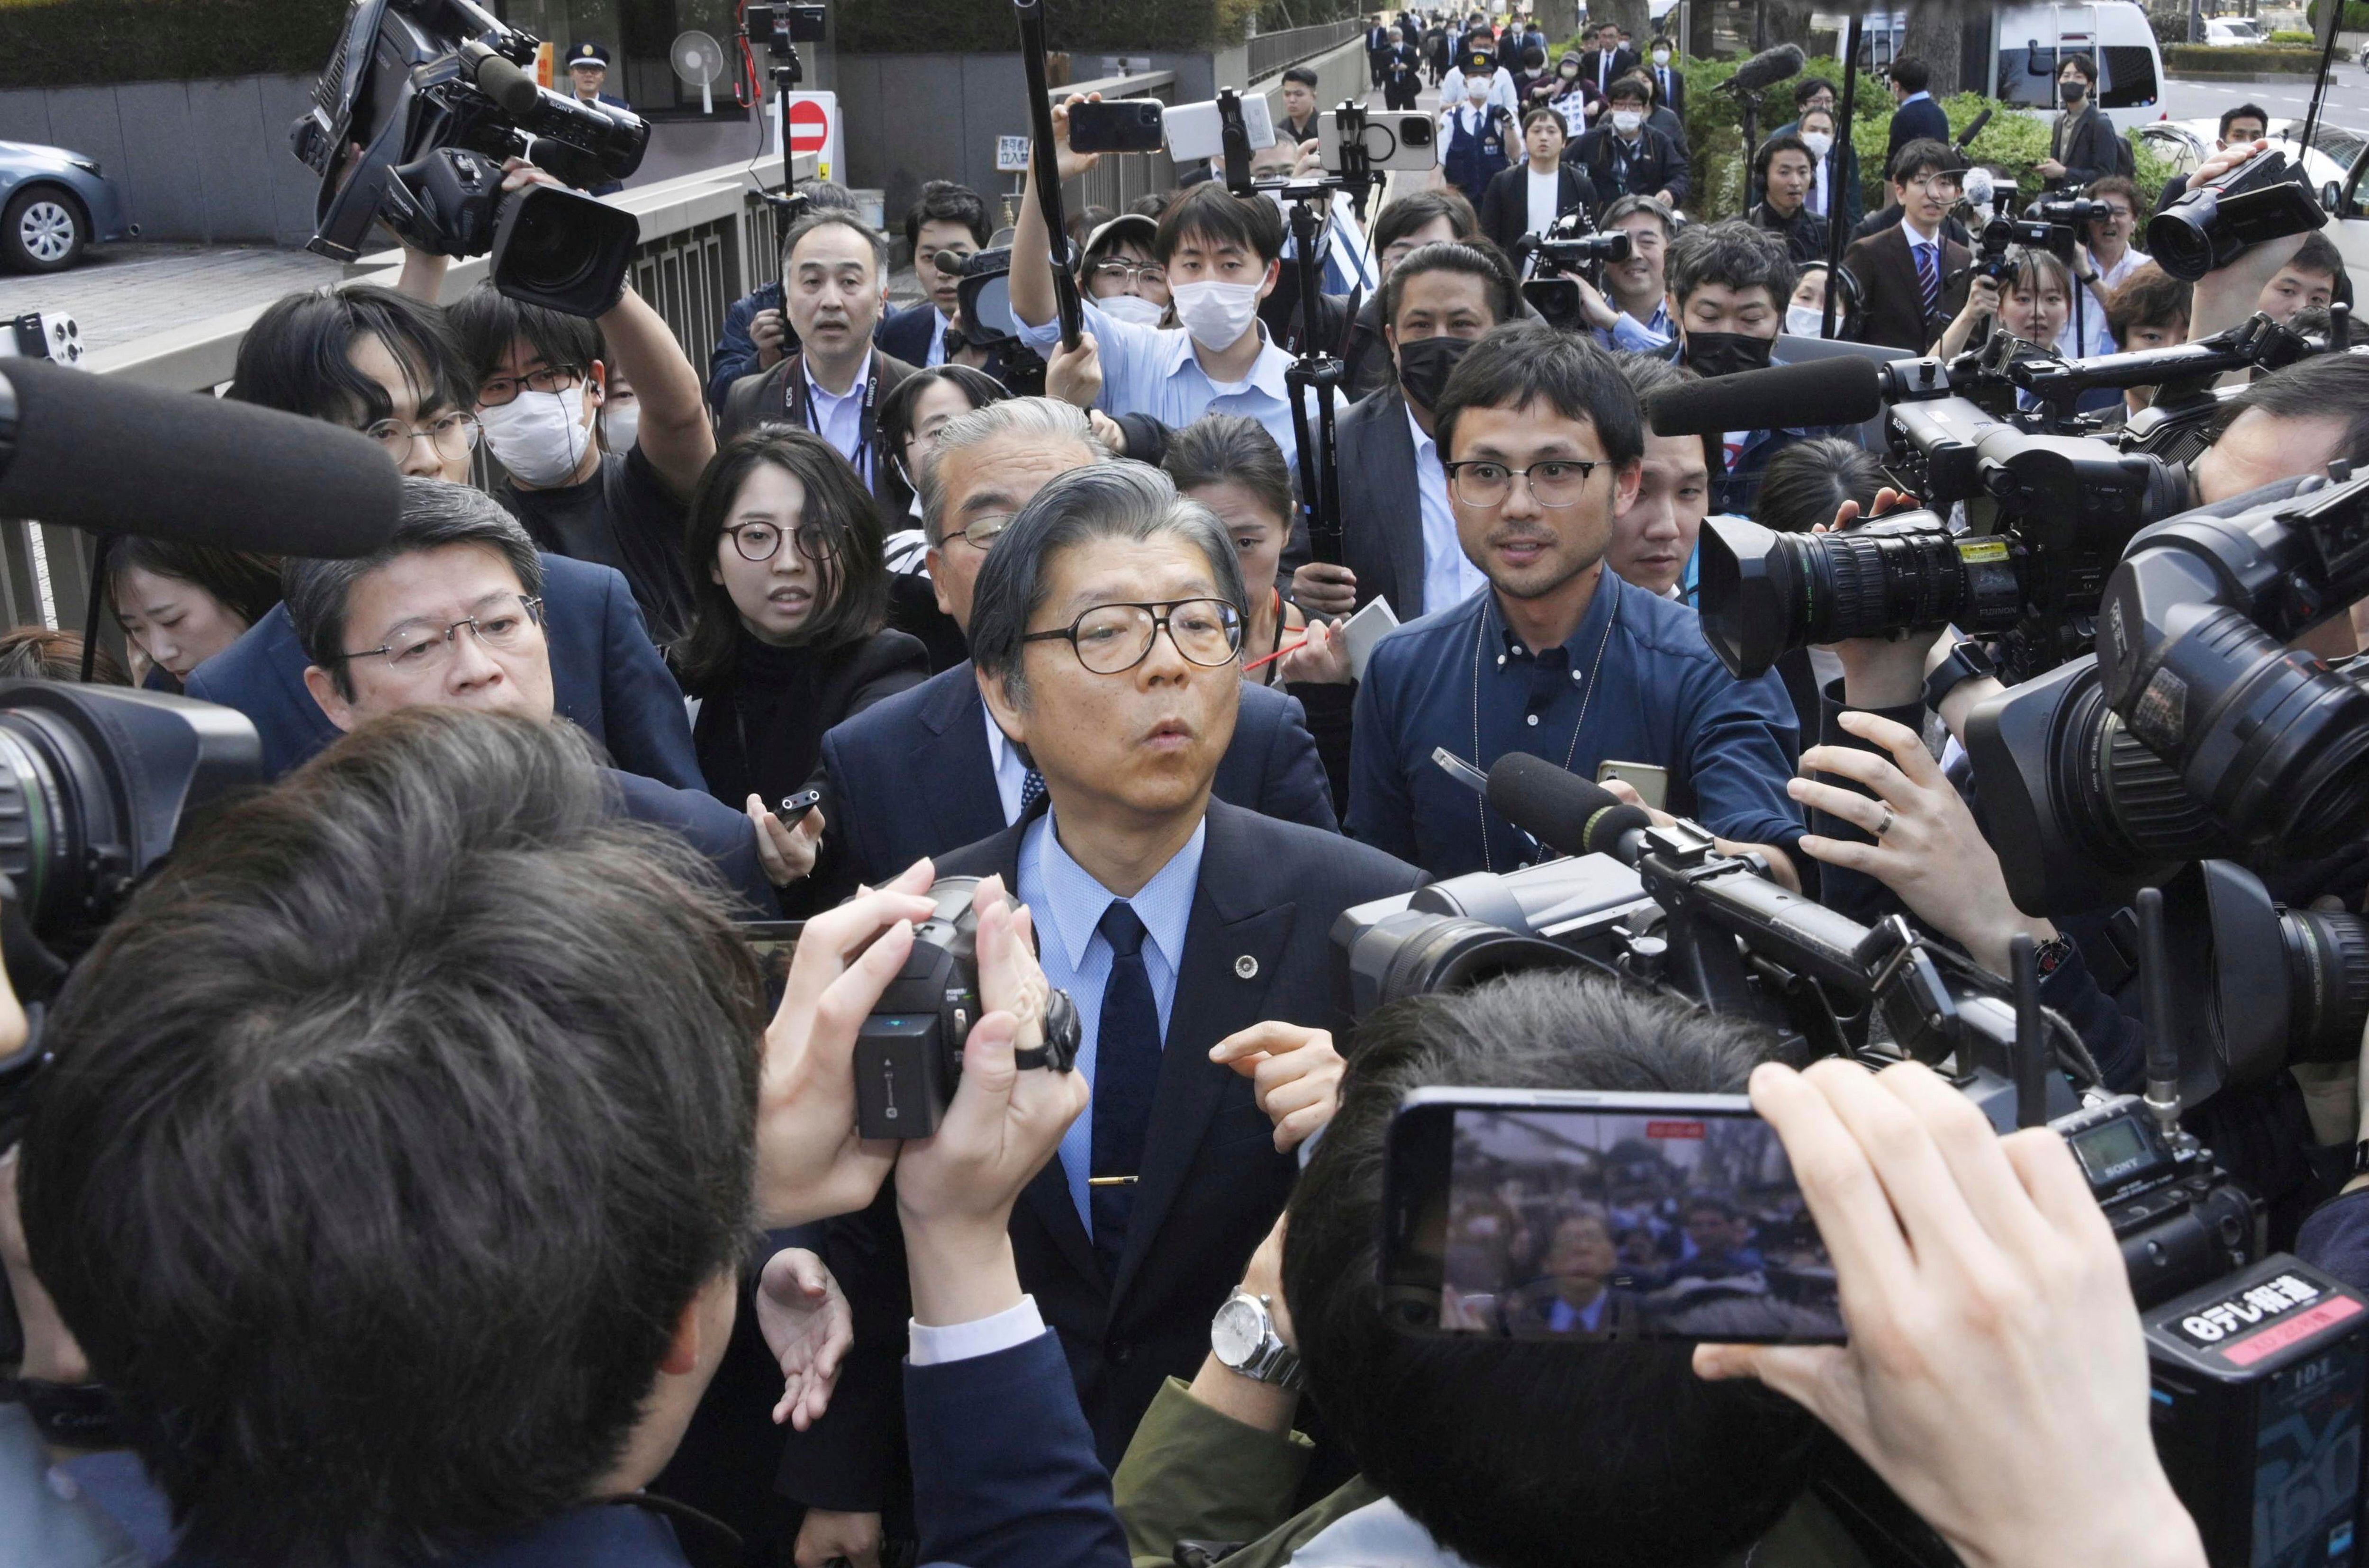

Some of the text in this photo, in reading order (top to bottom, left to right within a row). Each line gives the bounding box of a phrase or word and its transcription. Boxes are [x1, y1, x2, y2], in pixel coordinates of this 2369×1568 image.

[549, 100, 573, 114] SONY
[867, 377, 877, 407] Canon
[1892, 417, 1909, 434] SONY
[1980, 606, 2017, 617] FUJINON
[2105, 1157, 2138, 1178] SONY
